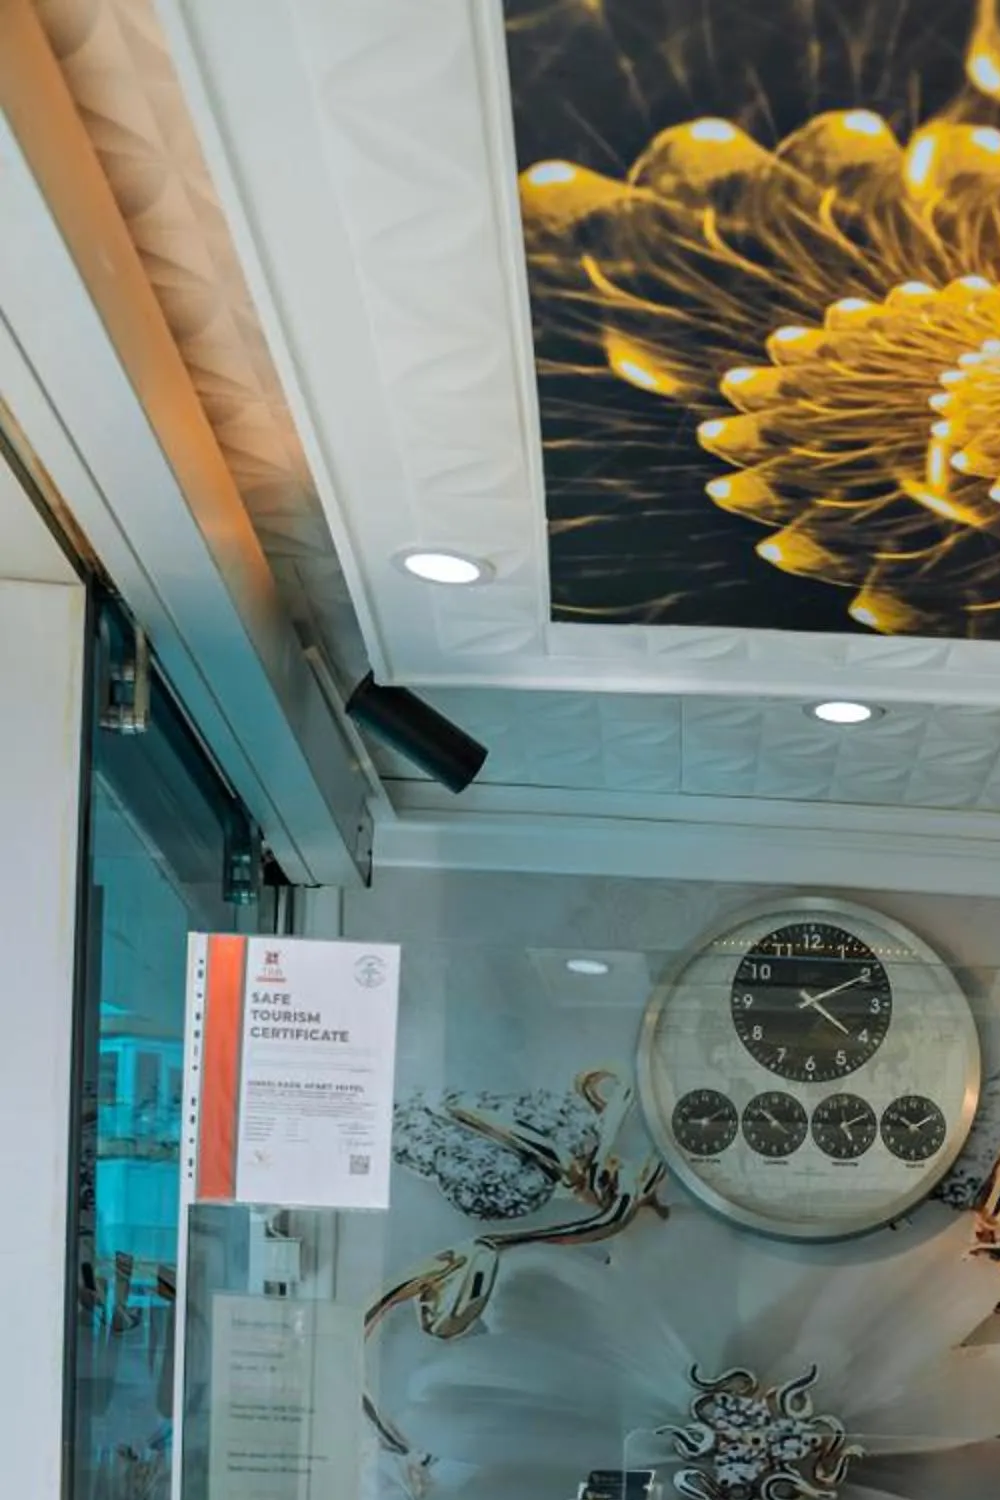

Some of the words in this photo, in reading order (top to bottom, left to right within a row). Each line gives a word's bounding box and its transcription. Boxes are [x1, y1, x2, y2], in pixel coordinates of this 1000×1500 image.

[803, 934, 824, 949] 12
[751, 964, 771, 980] 10
[861, 967, 871, 983] 2
[251, 991, 291, 1005] SAFE
[743, 991, 753, 1006] 9
[870, 998, 881, 1014] 3
[250, 1009, 321, 1025] TOURISM
[250, 1027, 350, 1043] CERTIFICATE
[752, 1025, 763, 1041] 8
[858, 1028, 869, 1043] 4
[776, 1047, 787, 1063] 7
[805, 1055, 816, 1071] 6
[835, 1049, 847, 1065] 5
